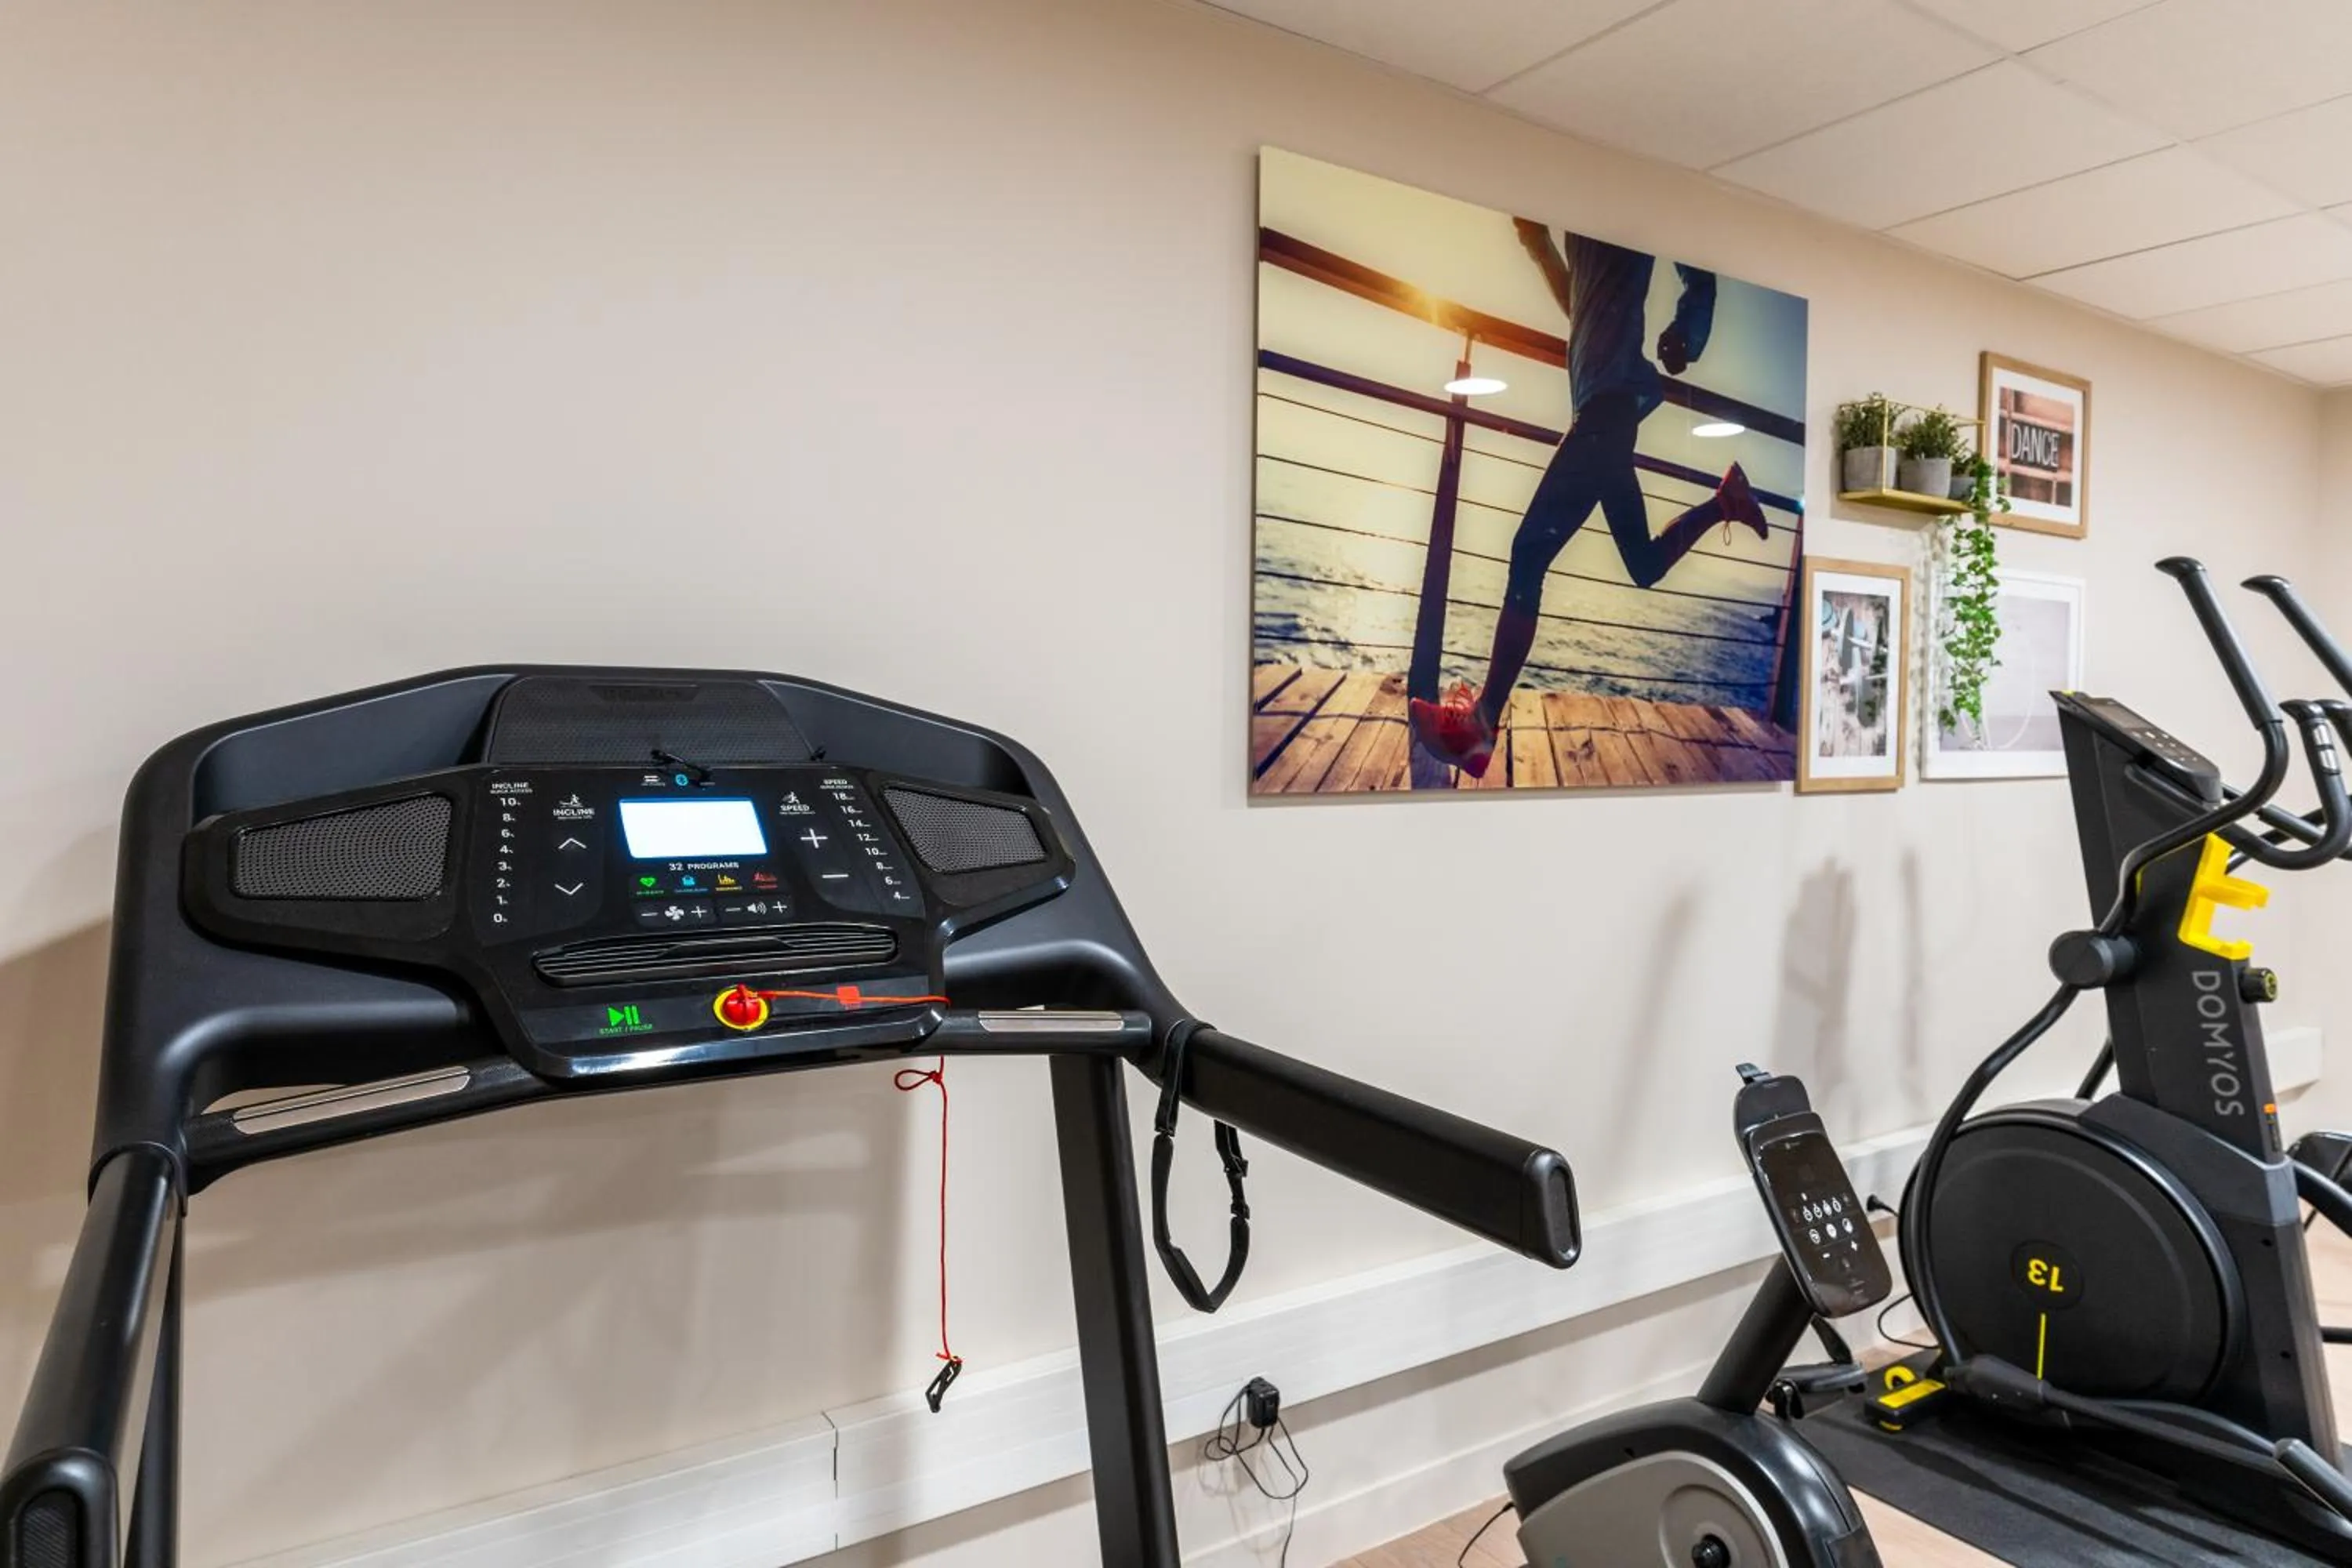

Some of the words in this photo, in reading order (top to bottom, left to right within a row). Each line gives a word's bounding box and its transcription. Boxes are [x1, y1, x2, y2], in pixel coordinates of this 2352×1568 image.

[2011, 423, 2060, 468] DANCE
[500, 797, 517, 806] 10
[833, 792, 847, 801] 18
[840, 805, 855, 815] 16
[848, 819, 863, 828] 14
[856, 833, 870, 842] 12
[865, 847, 879, 856] 10
[668, 863, 684, 872] 32
[687, 861, 739, 870] PROGRAMS
[884, 876, 894, 886] 6
[2191, 971, 2245, 1116] DOMYOS
[2027, 1258, 2065, 1292] 13
